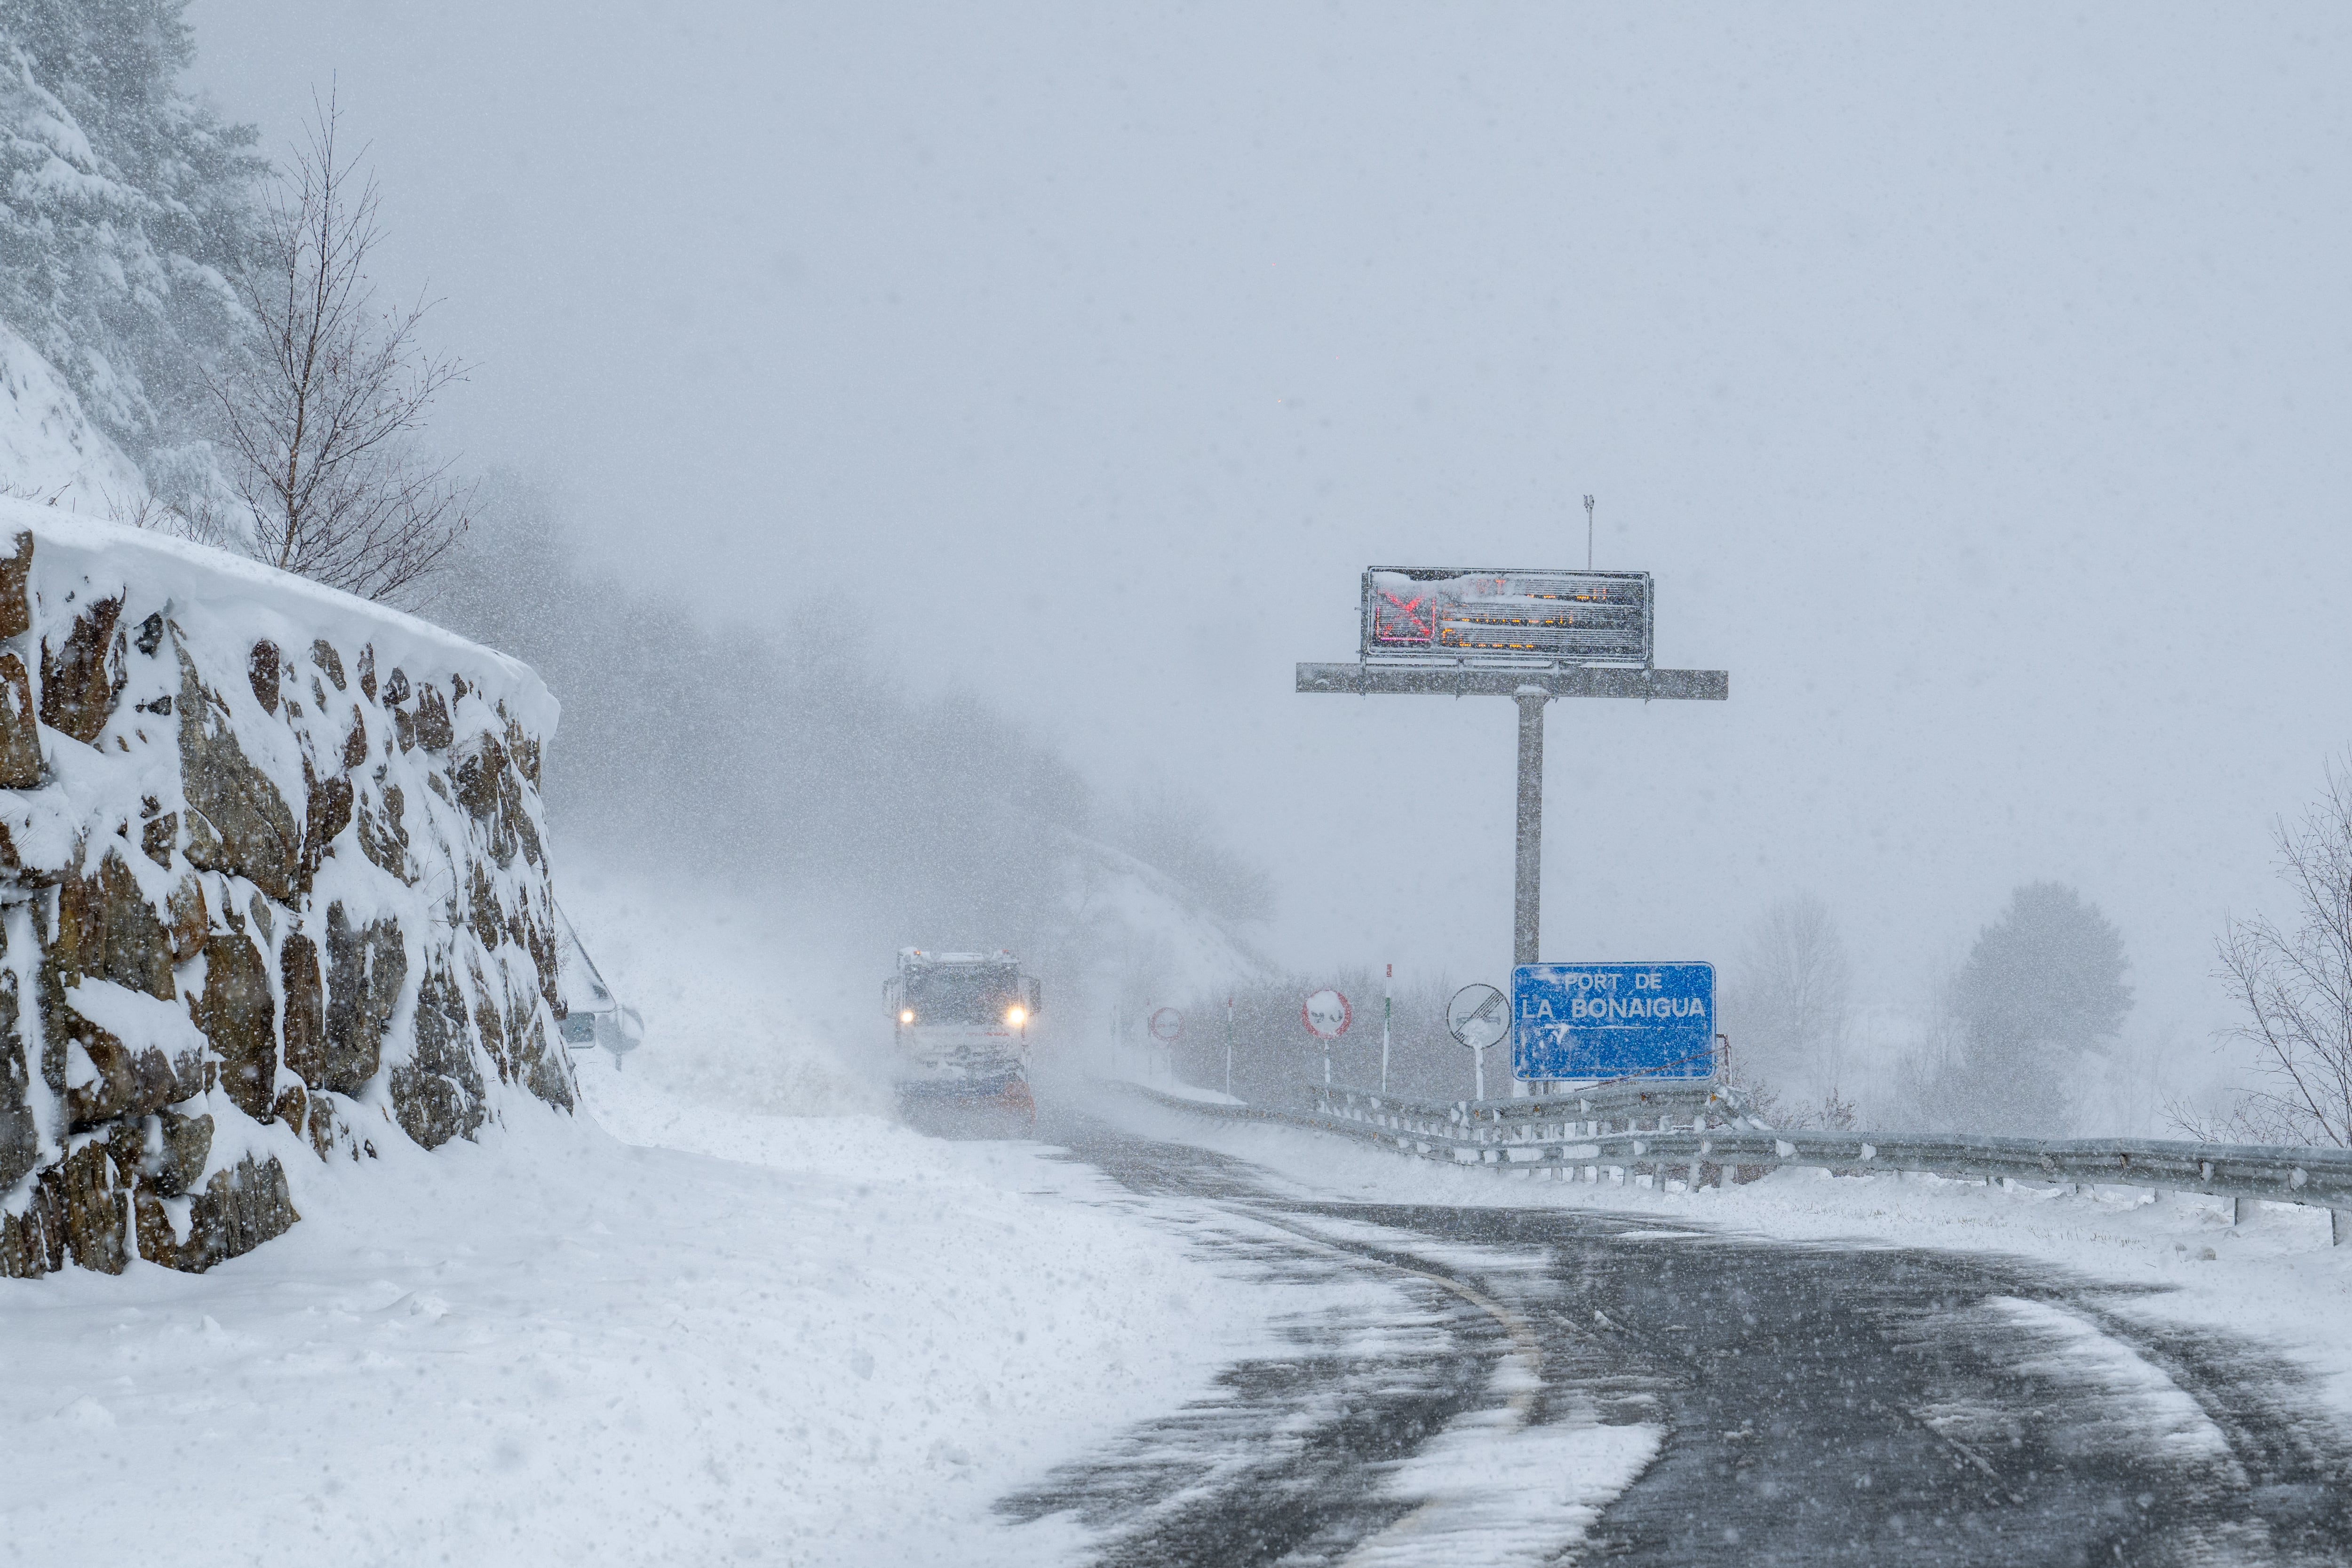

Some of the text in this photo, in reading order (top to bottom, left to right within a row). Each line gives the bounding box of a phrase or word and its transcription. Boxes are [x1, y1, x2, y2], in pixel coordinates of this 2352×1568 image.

[1565, 973, 1662, 990] PORT DE
[1522, 997, 1706, 1019] LA BONAIGUA
